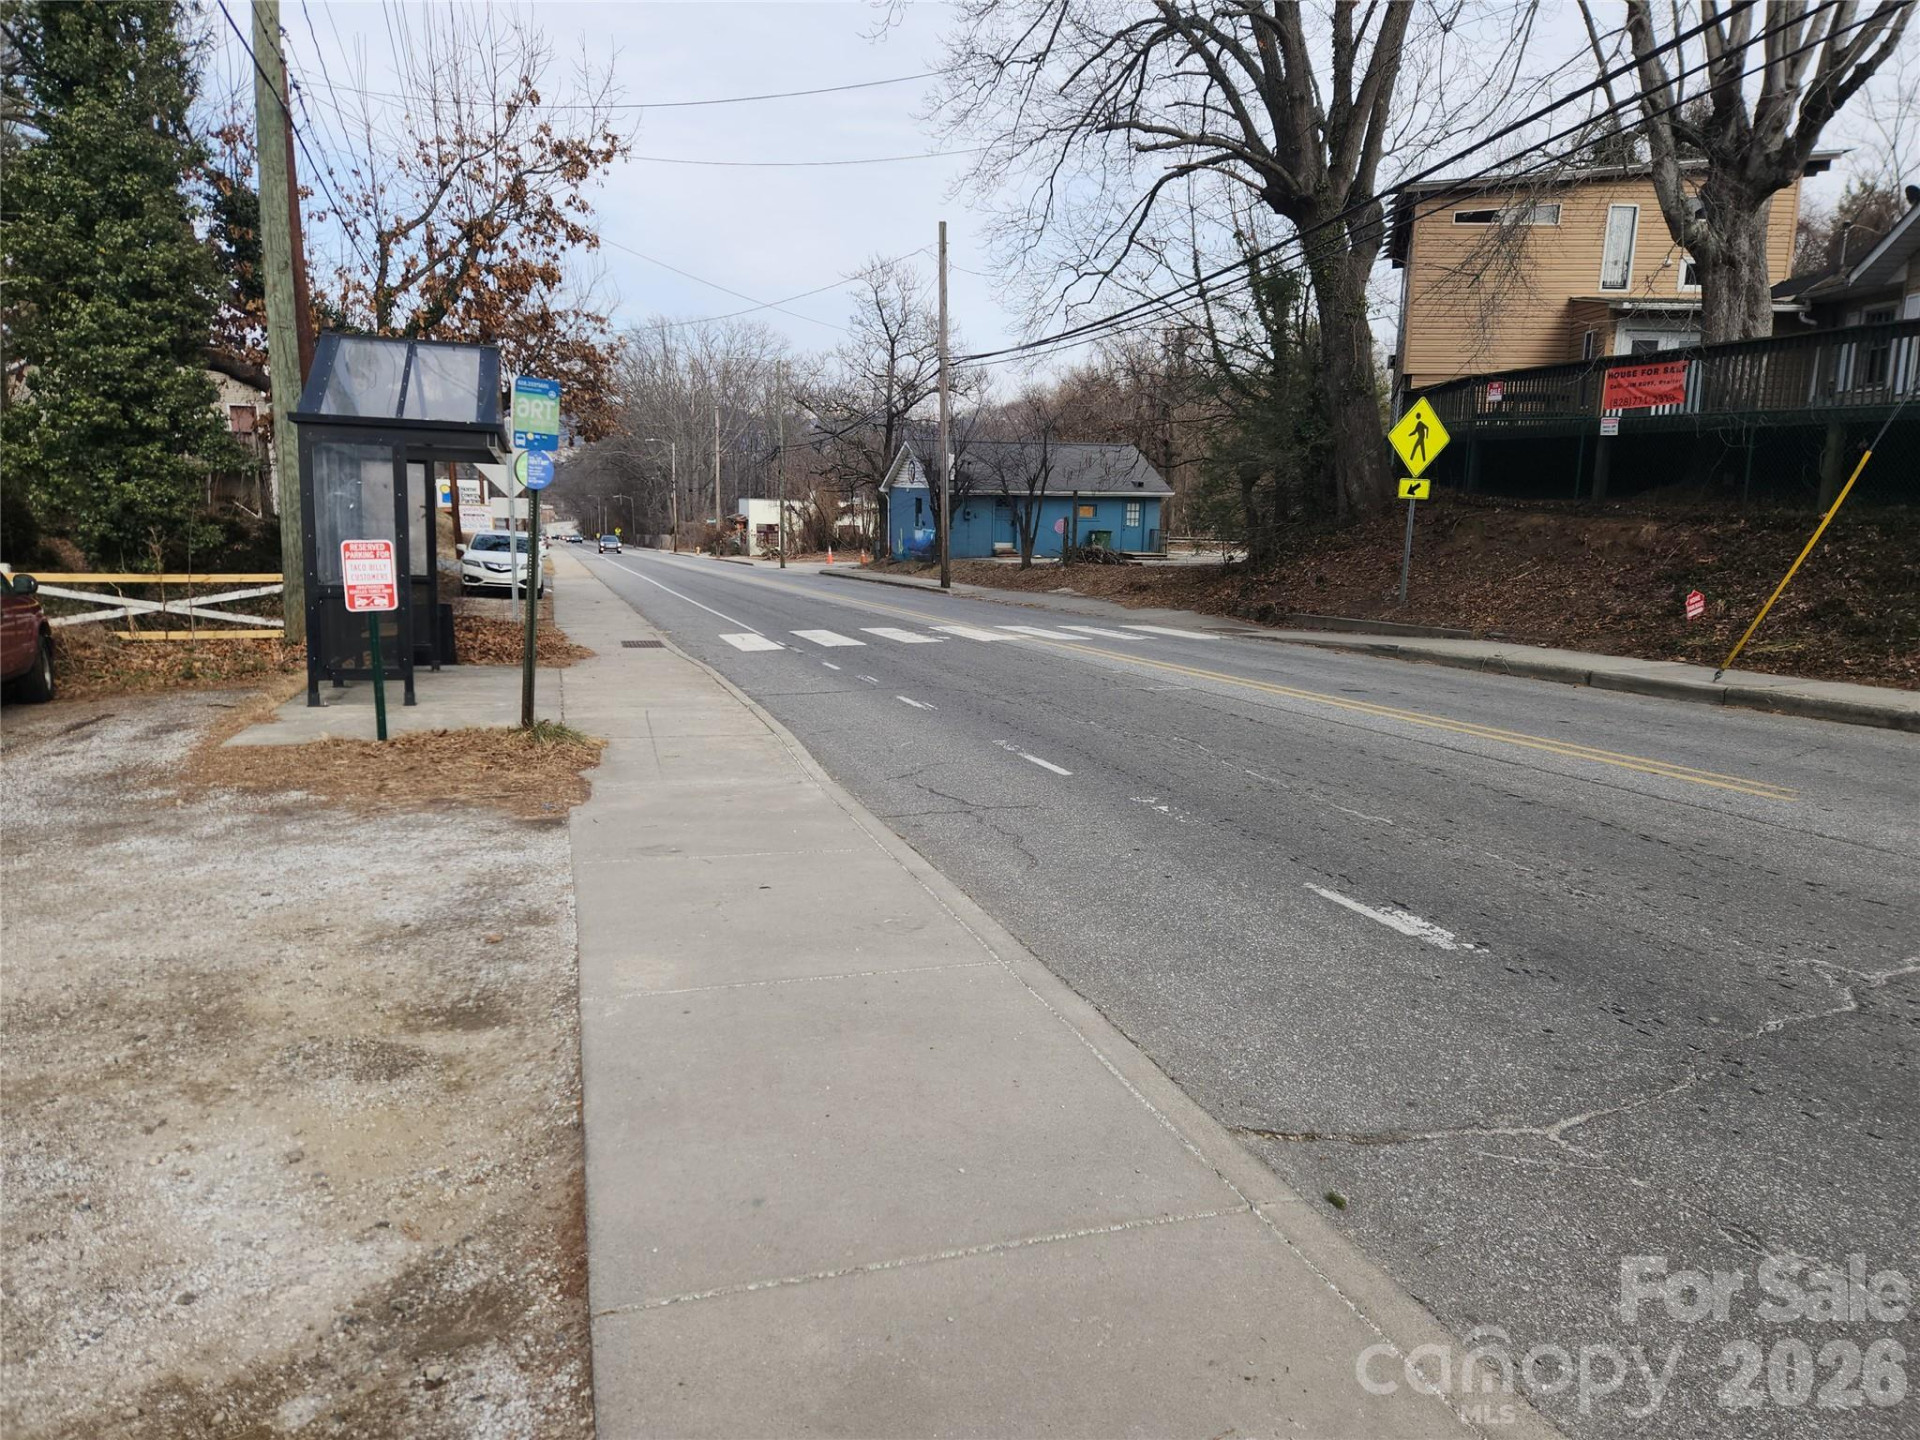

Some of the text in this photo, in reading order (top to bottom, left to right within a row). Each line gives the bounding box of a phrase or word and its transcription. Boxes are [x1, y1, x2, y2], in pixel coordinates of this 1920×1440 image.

[1608, 365, 1688, 379] HOUSE FOR SALE
[350, 543, 385, 551] RESERVED
[345, 550, 390, 559] PARKING FOR
[351, 573, 388, 581] CUSTOMERS
